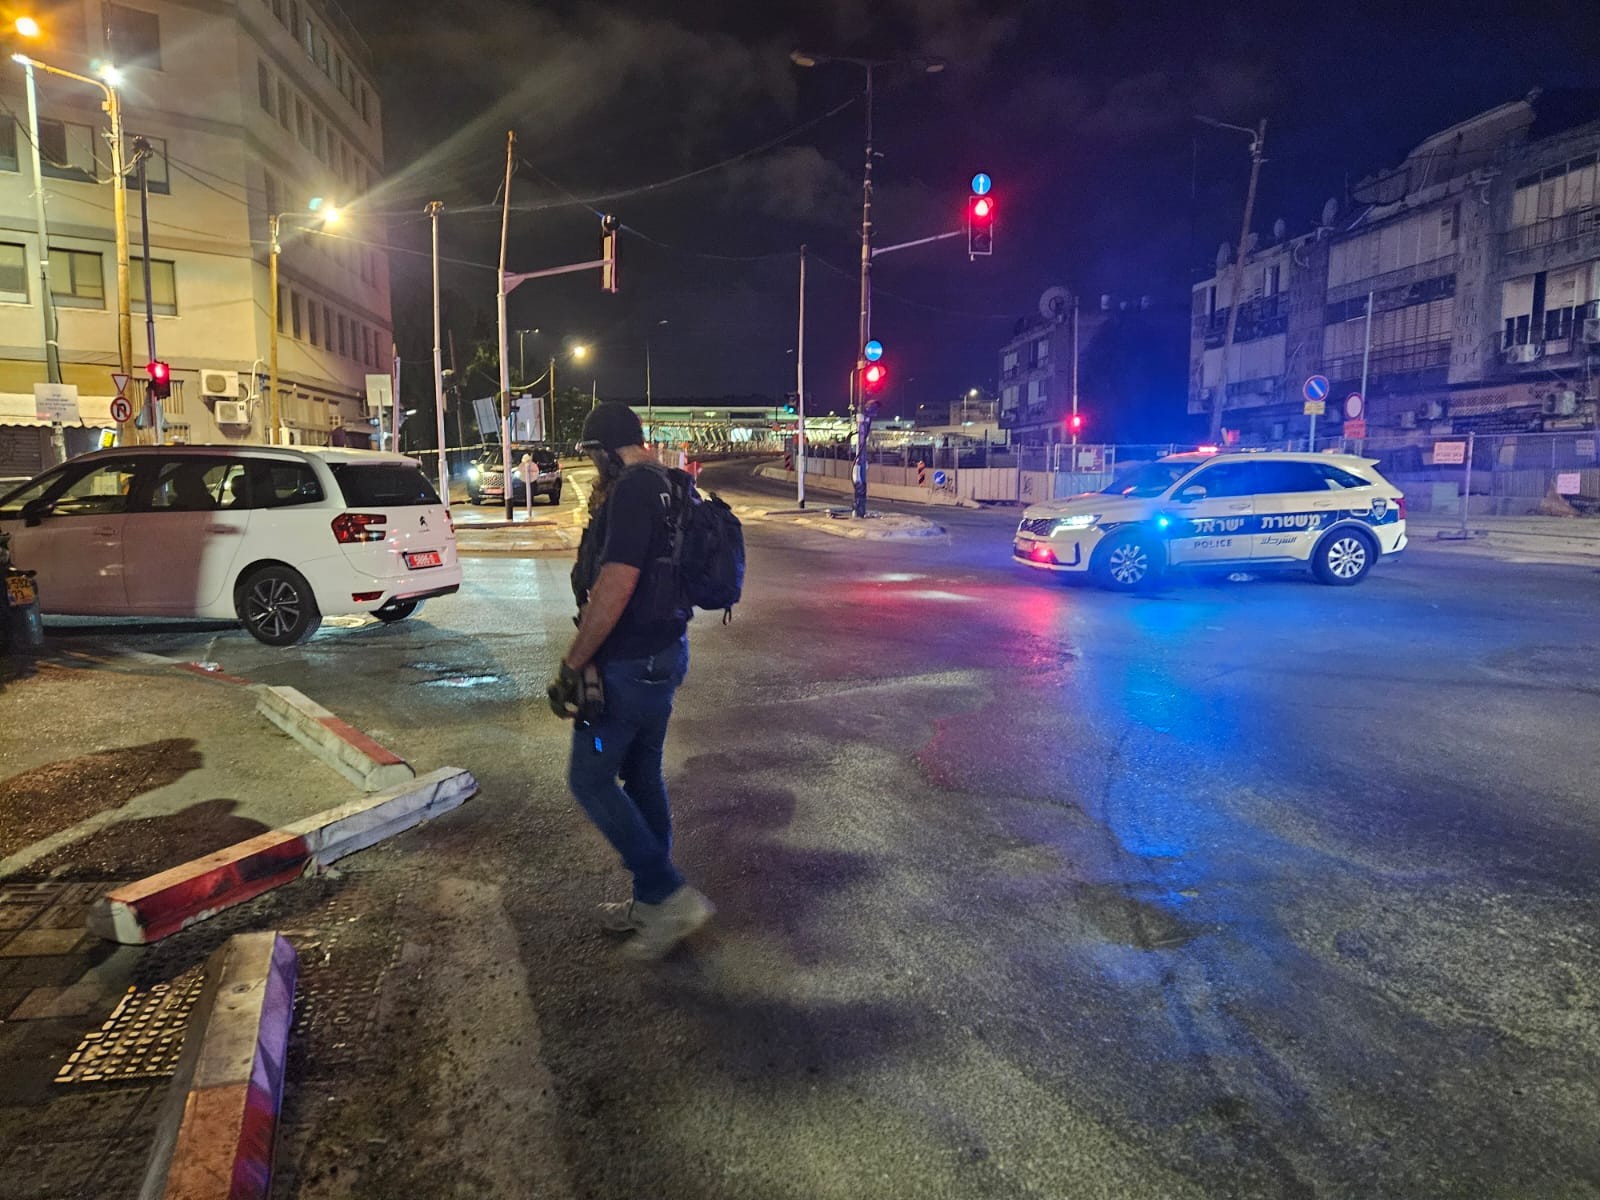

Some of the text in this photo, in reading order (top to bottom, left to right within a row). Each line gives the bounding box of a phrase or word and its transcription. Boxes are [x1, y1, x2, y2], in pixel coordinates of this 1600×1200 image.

[1193, 514, 1320, 533] משטרת ישראל
[1194, 539, 1232, 549] POLICE
